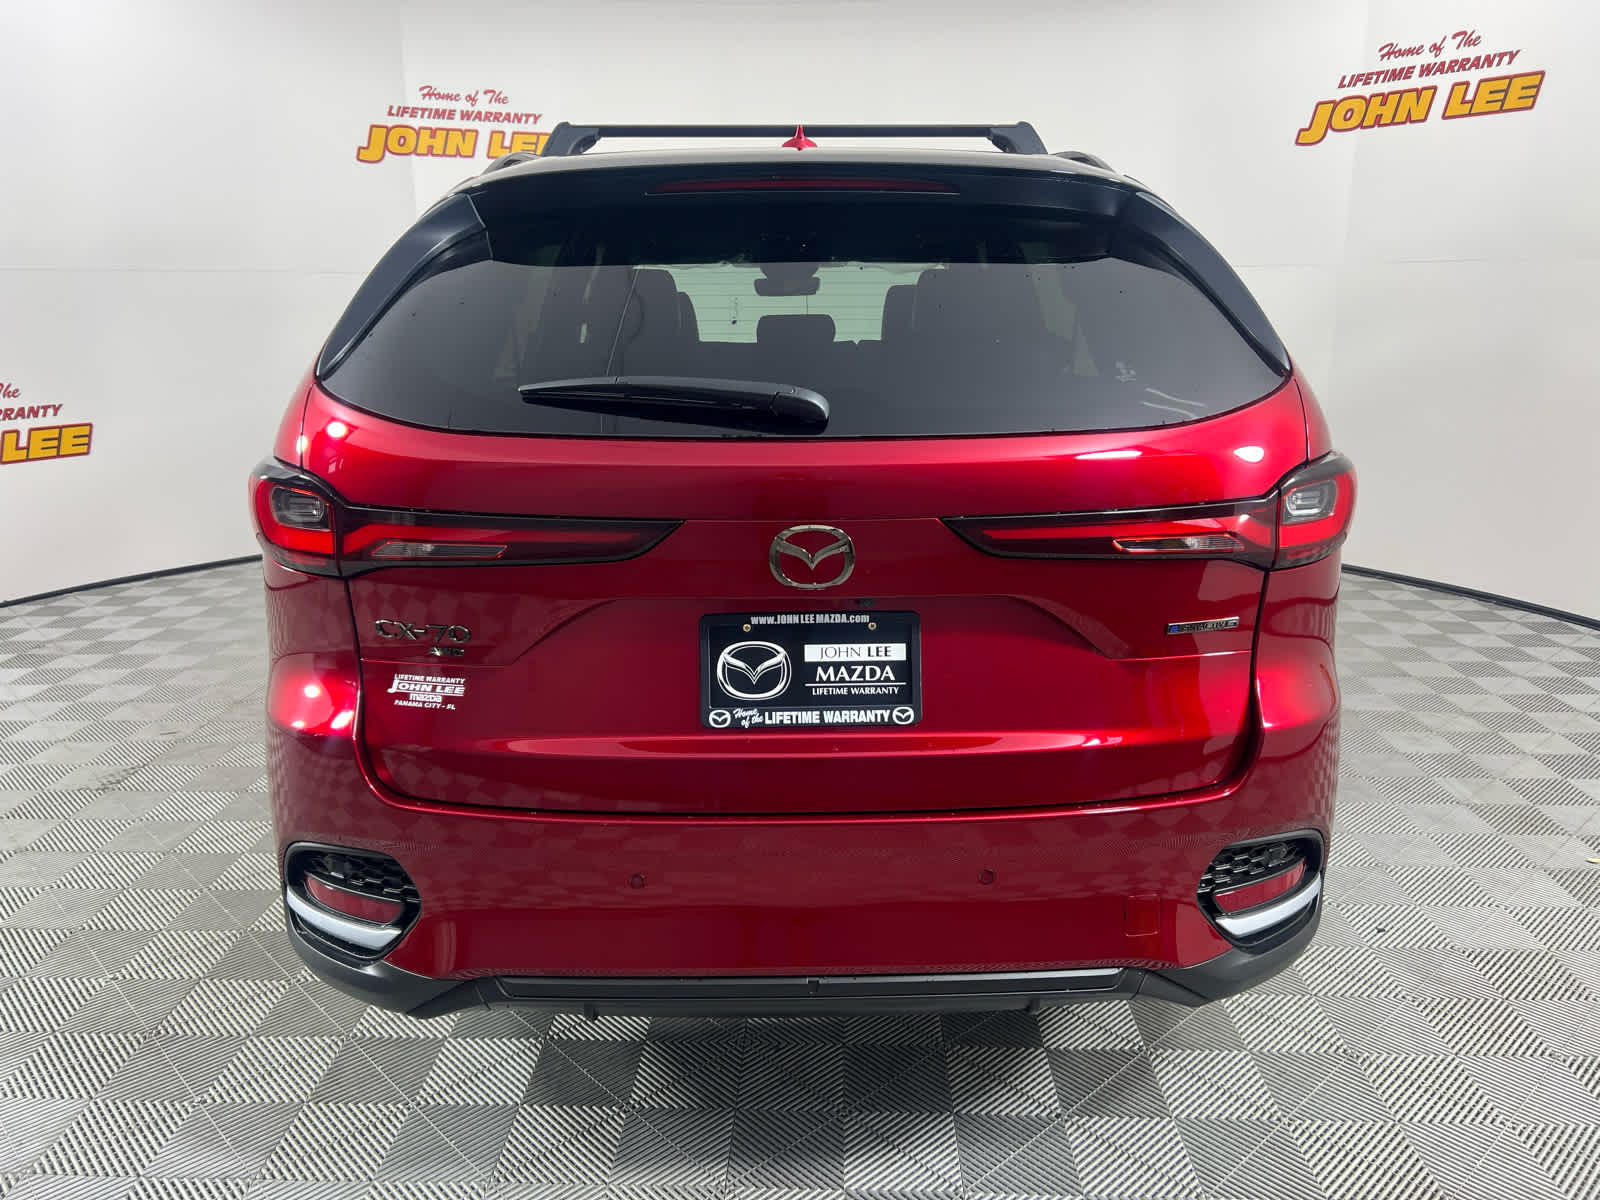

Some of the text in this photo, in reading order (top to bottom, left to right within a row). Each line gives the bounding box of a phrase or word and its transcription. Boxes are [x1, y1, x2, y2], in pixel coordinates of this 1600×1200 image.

[1378, 30, 1481, 61] Home of The
[1337, 50, 1521, 88] LIFETIME WARRANTY
[418, 85, 510, 106] Home of The
[387, 104, 543, 125] LIFETIME WARRANTY
[1295, 70, 1546, 146] JOHN LEE
[356, 124, 479, 163] JOHN
[0, 422, 93, 465] LEE
[375, 619, 471, 644] CX-70
[820, 645, 892, 660] JOHN LEE
[394, 673, 466, 684] LIFETIME WARRANTY
[815, 665, 896, 682] MAZDA
[387, 680, 466, 695] JOHN LEE
[812, 686, 899, 696] LIFETIME WARRANTY
[394, 700, 423, 708] PANAMA
[733, 708, 758, 719] Home
[741, 713, 763, 728] of the
[764, 709, 890, 725] LIFETIME WARRANTY
